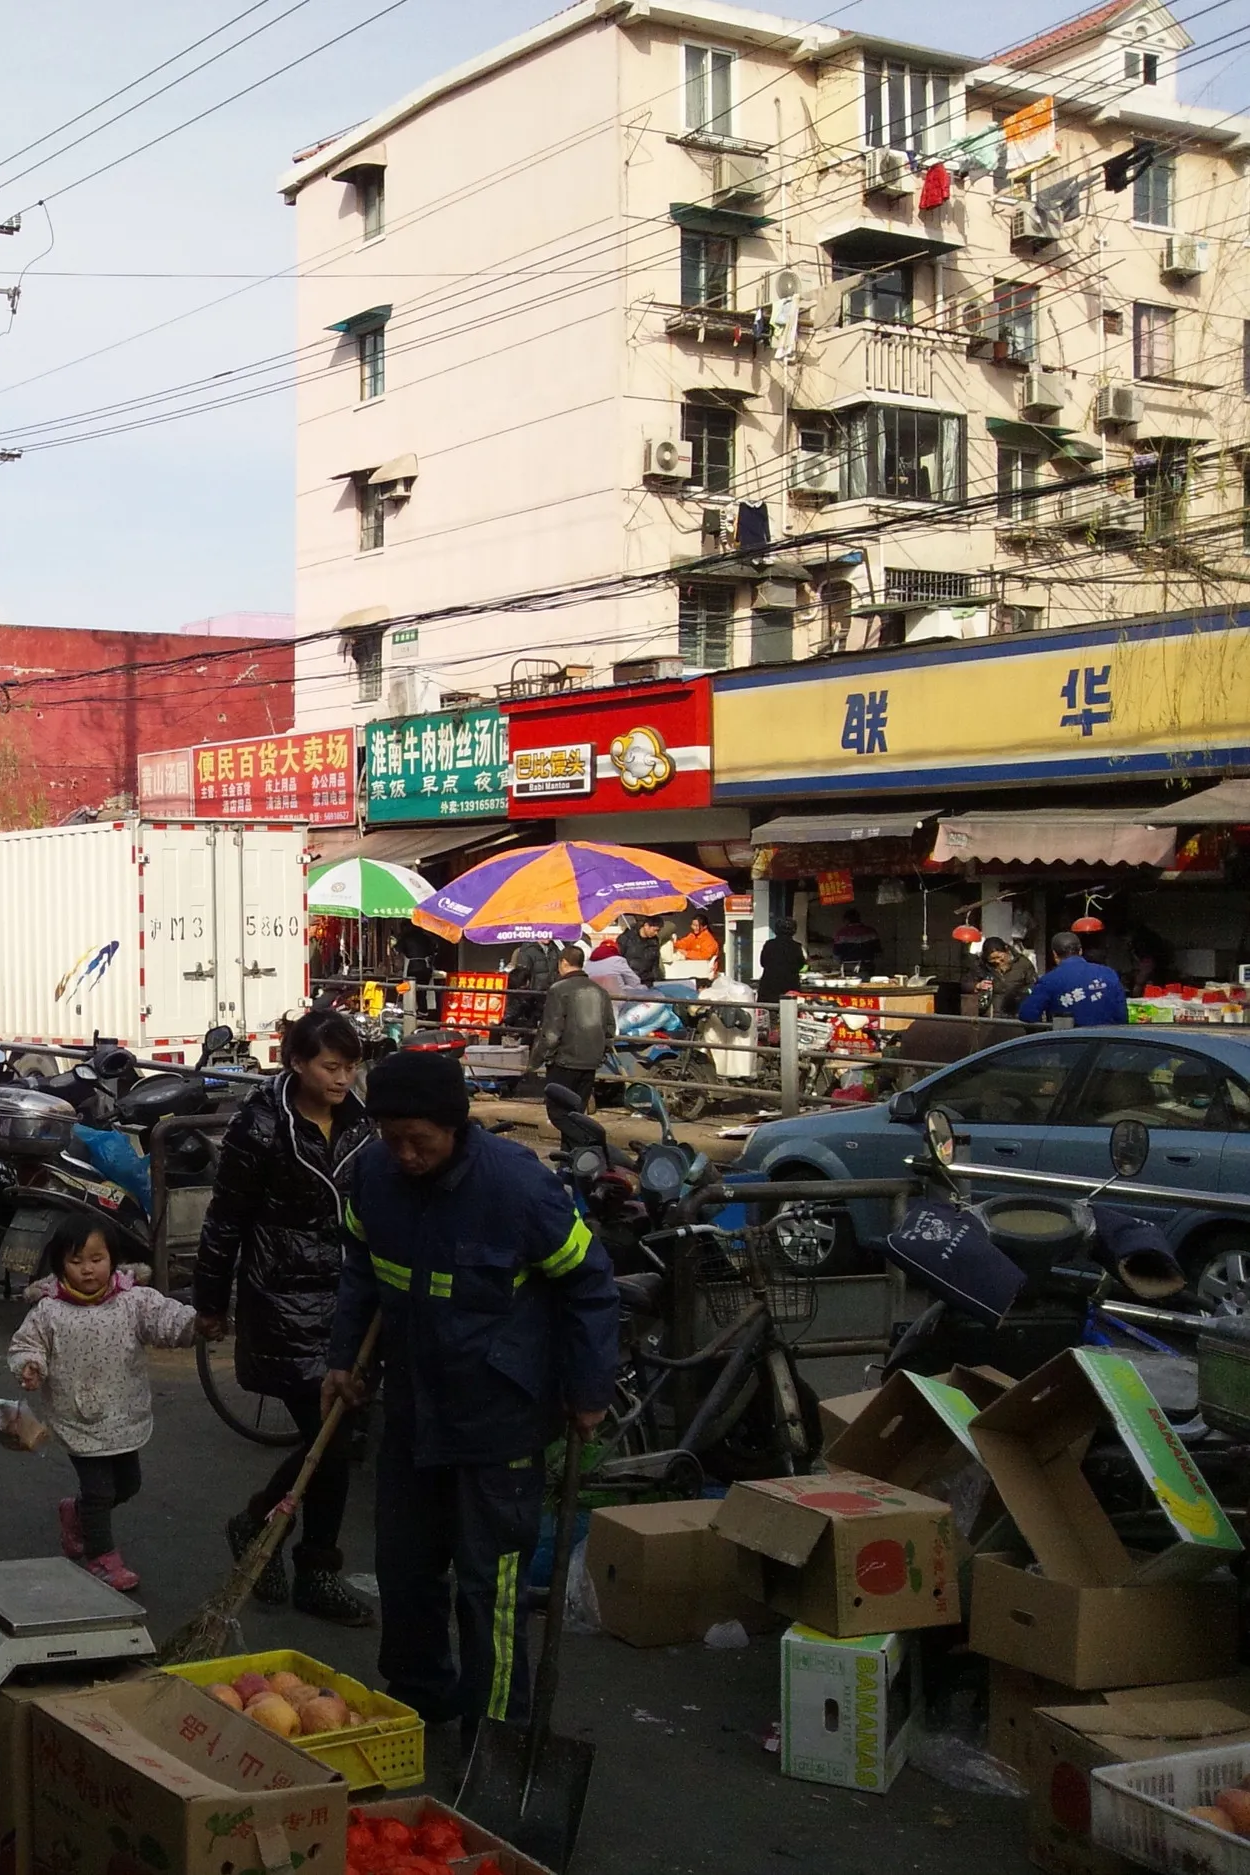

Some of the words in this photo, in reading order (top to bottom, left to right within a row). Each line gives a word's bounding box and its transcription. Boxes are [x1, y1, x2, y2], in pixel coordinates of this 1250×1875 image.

[198, 733, 348, 783] 便民百货大卖场
[516, 748, 586, 780] 巴比馒头
[141, 761, 189, 797] 黄山汤圆
[221, 781, 251, 797] 五金百货
[265, 777, 297, 793] 床上用品
[312, 772, 346, 789] 办公用品
[421, 775, 459, 797] 早点
[528, 782, 544, 792] Babi
[545, 780, 571, 791] Mantou
[246, 915, 299, 938] 5860
[496, 930, 554, 941] 4001-001-001
[1148, 1407, 1207, 1497] BANANAS
[855, 1656, 879, 1788] BANANAS
